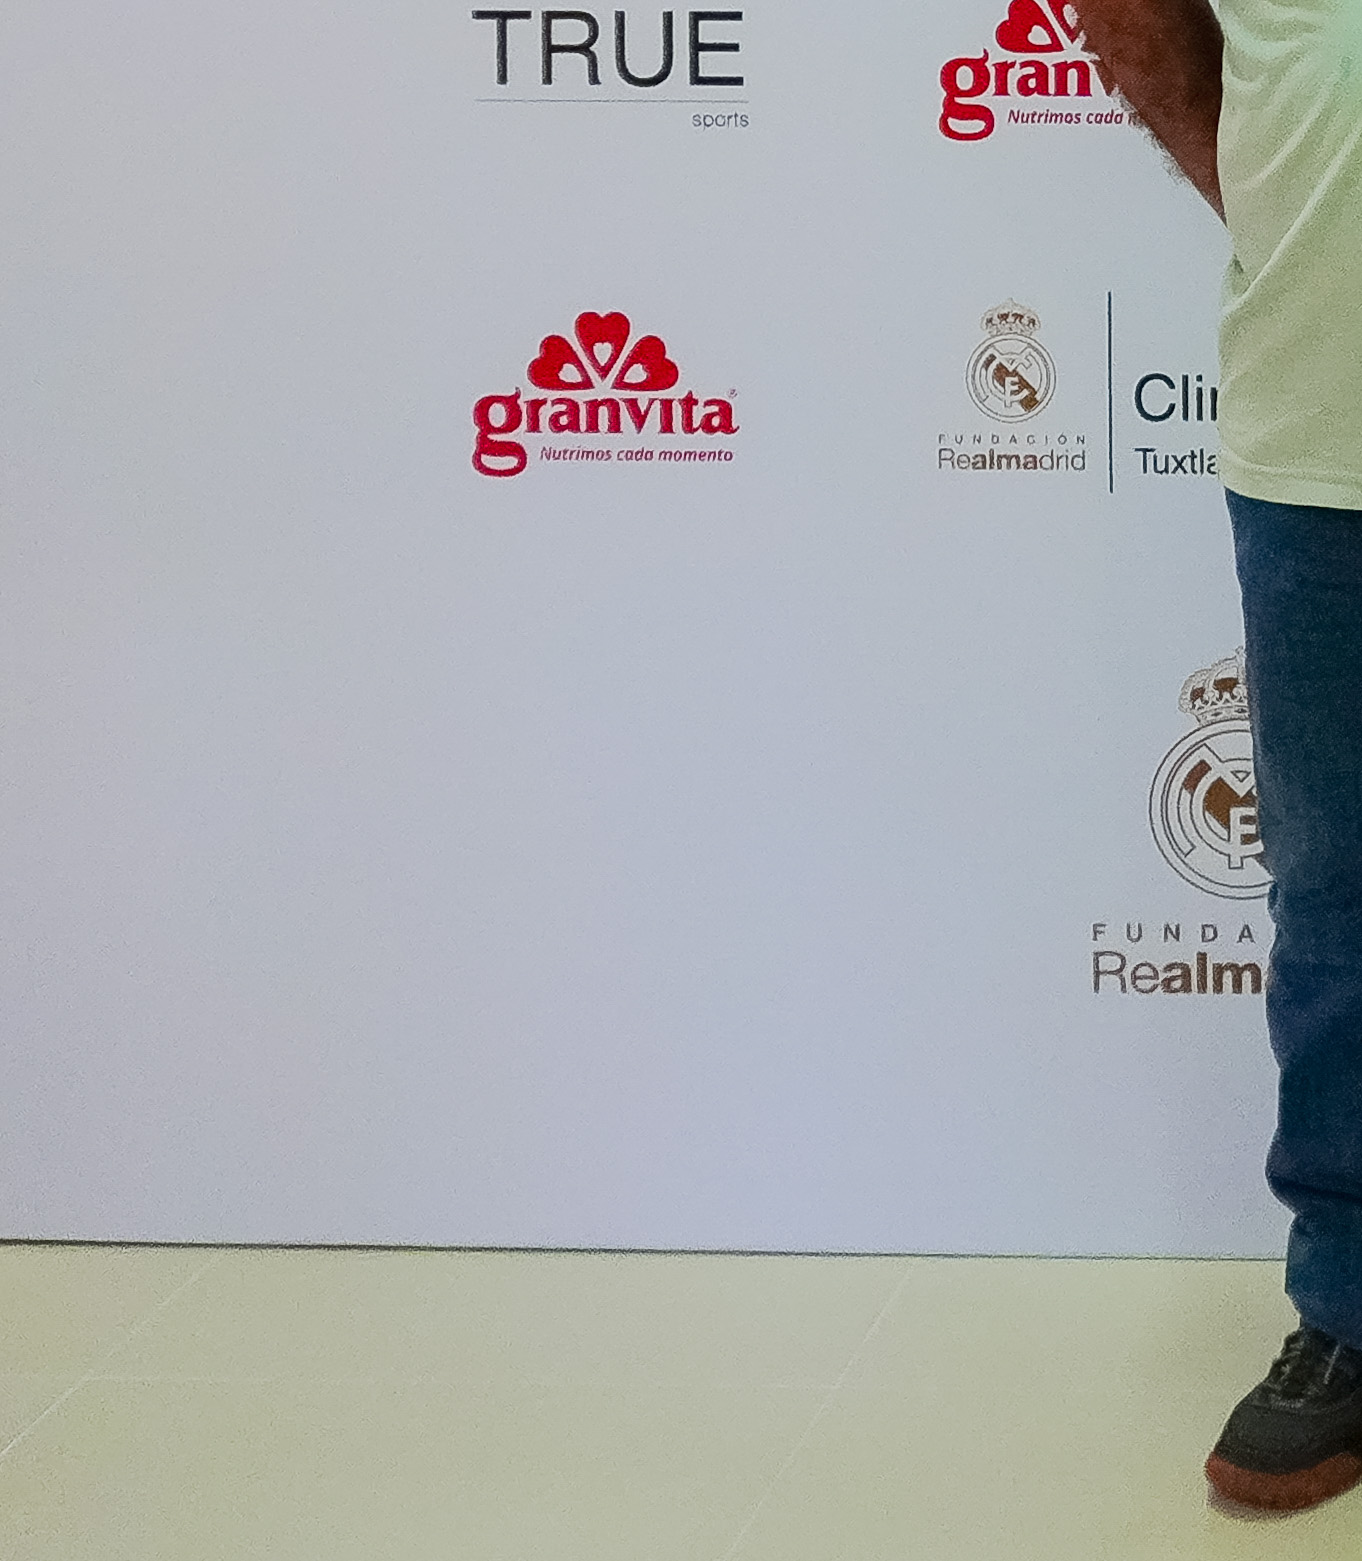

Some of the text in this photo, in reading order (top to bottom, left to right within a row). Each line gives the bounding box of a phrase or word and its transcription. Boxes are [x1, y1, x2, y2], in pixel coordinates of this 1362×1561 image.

[472, 10, 743, 87] TRUE
[939, 48, 1092, 141] gran
[693, 112, 749, 130] sports
[1008, 109, 1081, 124] Nutrimos
[1086, 109, 1123, 124] cada
[472, 387, 740, 478] granvita
[939, 433, 1085, 445] FUNDACIÓN
[540, 446, 733, 462] Nutrimos cada momento
[939, 448, 1085, 470] Realmadrid
[1093, 923, 1255, 943] FUNDA
[1092, 950, 1263, 994] Realm
